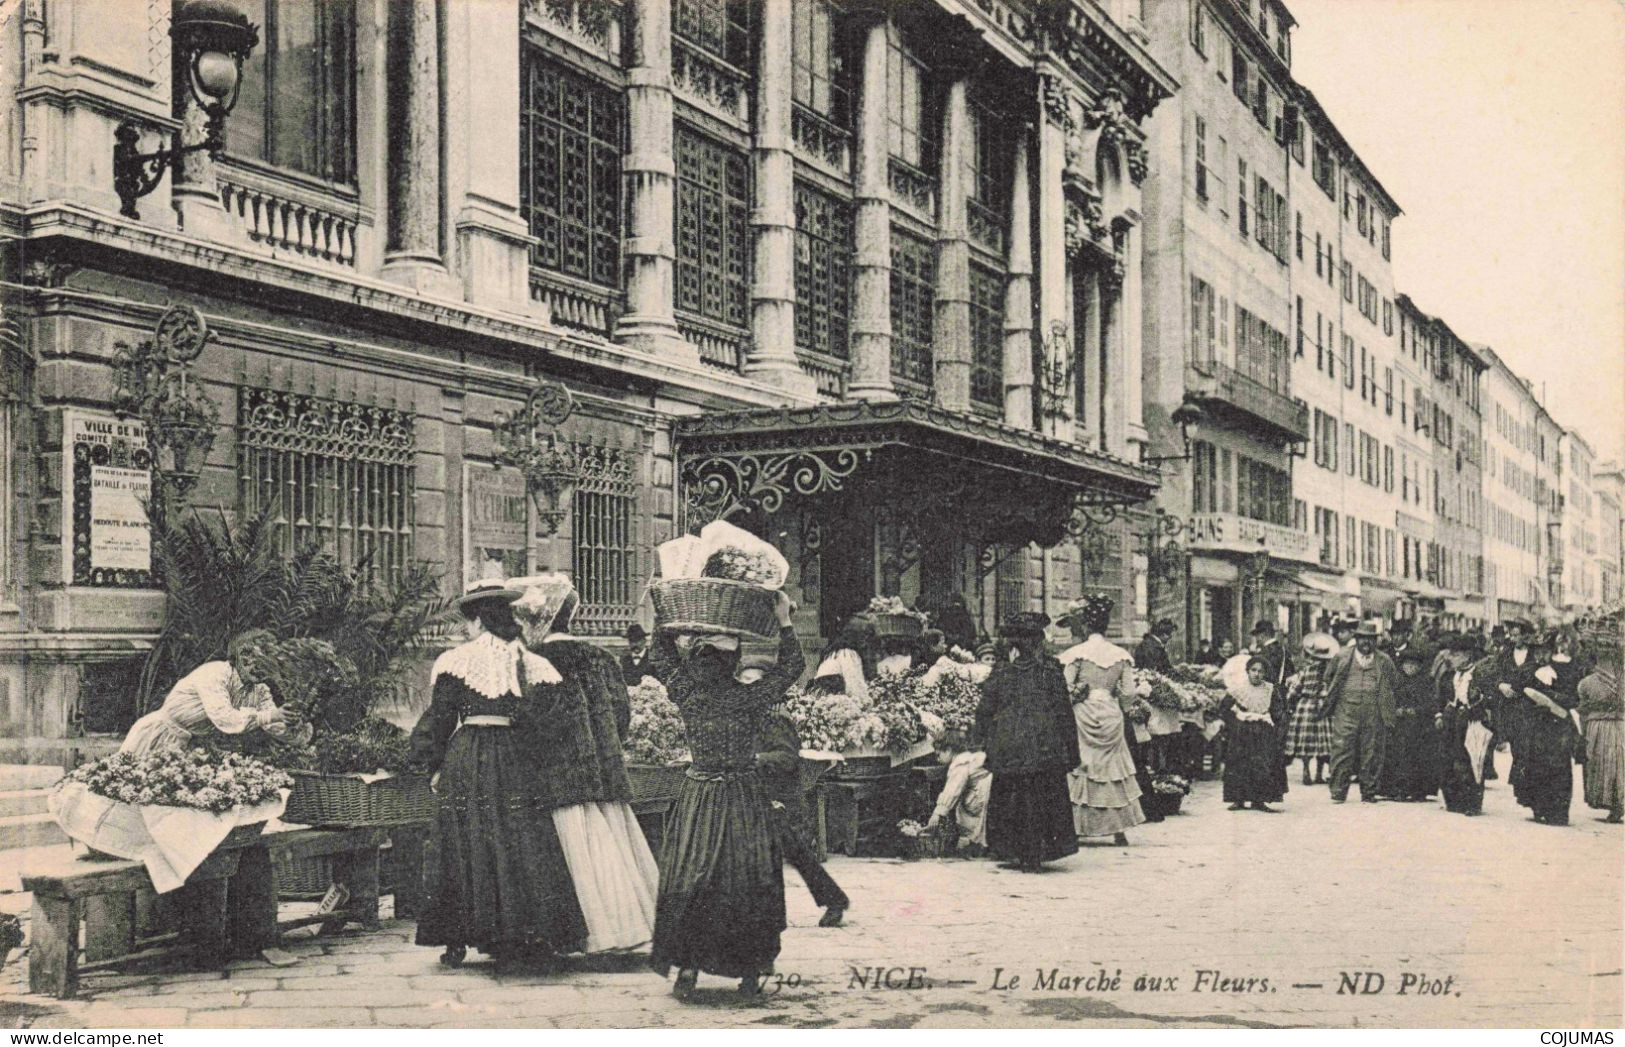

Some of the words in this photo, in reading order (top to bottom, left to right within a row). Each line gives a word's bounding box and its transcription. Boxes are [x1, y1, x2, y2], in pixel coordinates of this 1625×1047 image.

[84, 421, 113, 435] VILLE
[117, 425, 129, 437] DE
[75, 432, 108, 444] COMITÉ
[1189, 517, 1224, 543] BAINS
